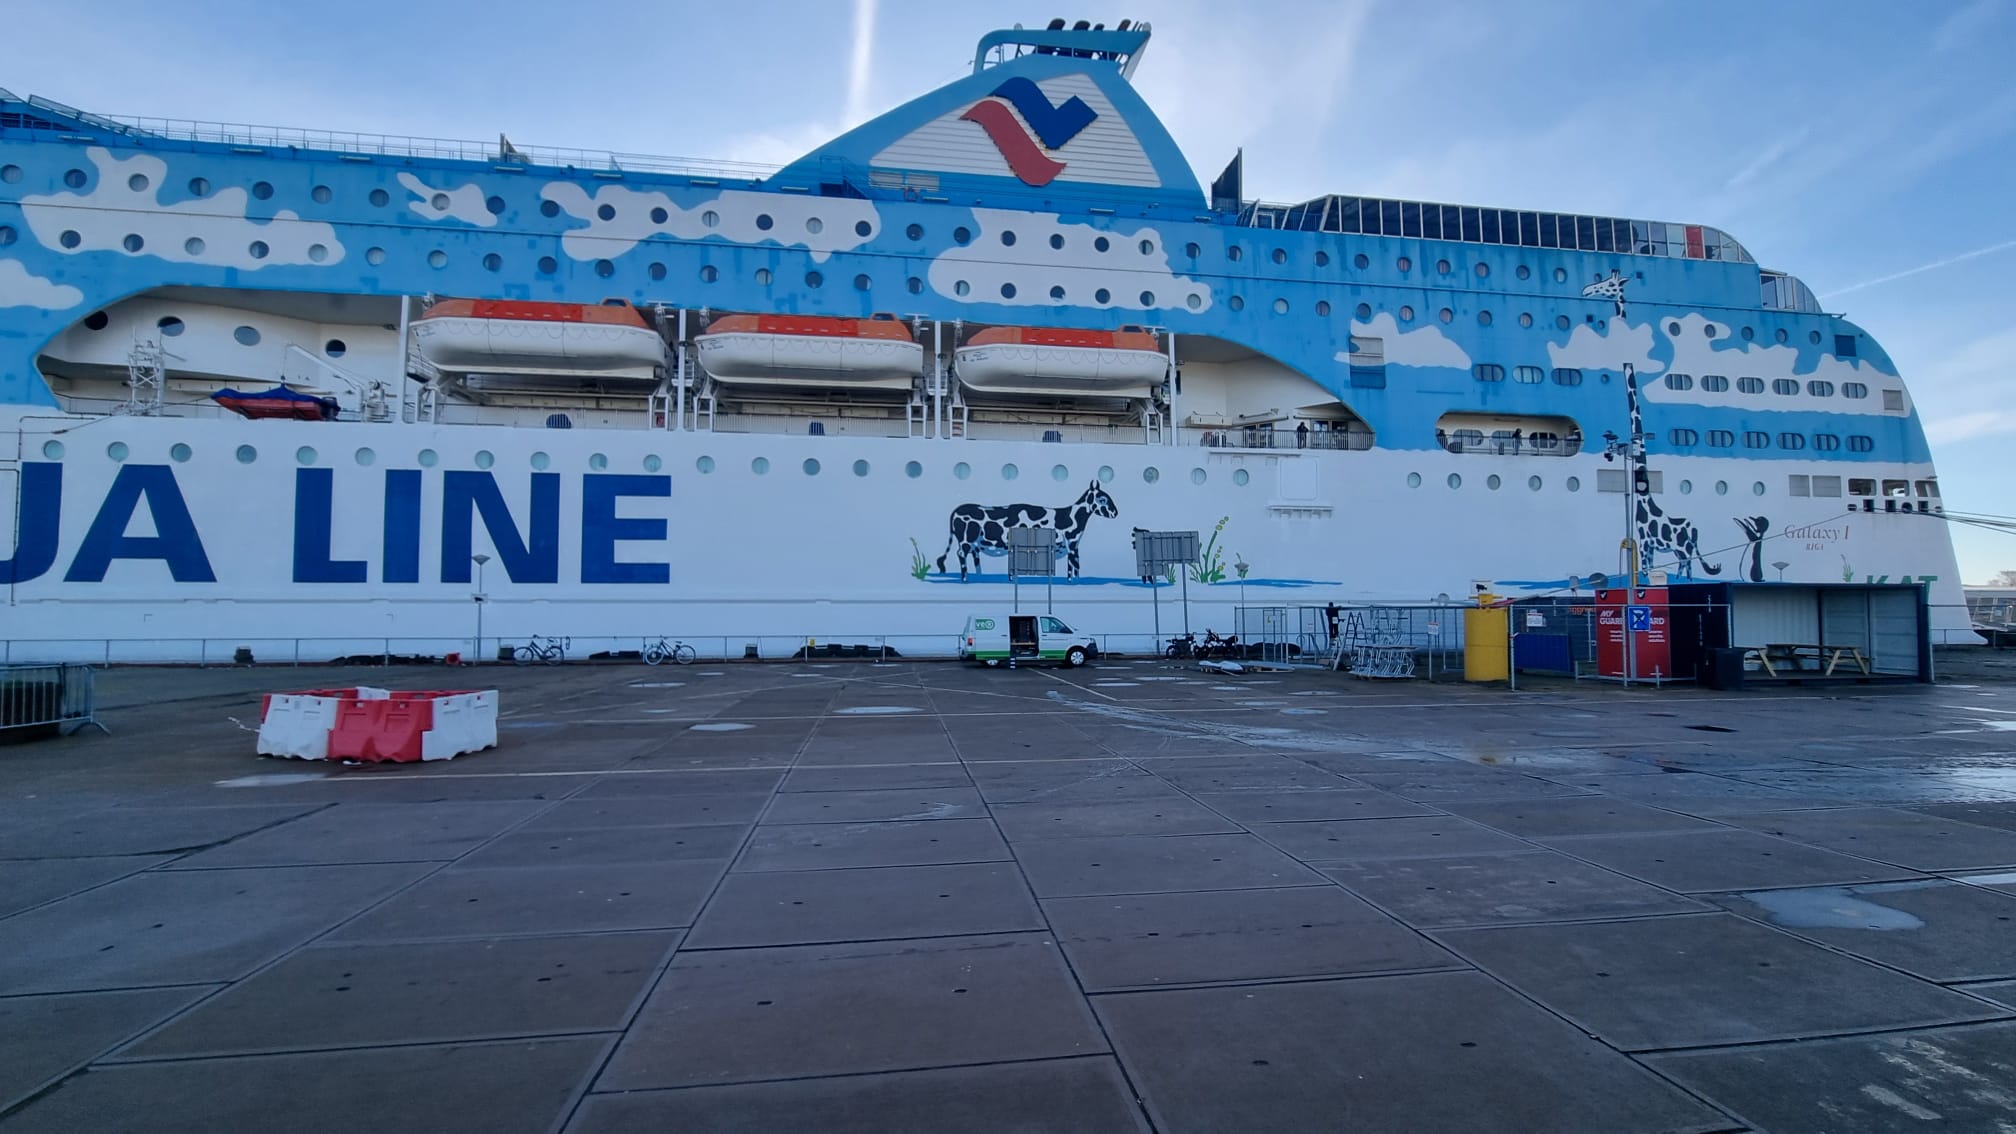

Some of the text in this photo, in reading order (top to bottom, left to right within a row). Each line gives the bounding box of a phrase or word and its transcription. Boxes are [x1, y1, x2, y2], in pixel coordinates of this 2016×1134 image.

[292, 467, 671, 584] LINE
[1784, 525, 1840, 543] Galaxy
[1600, 617, 1624, 625] GUAR
